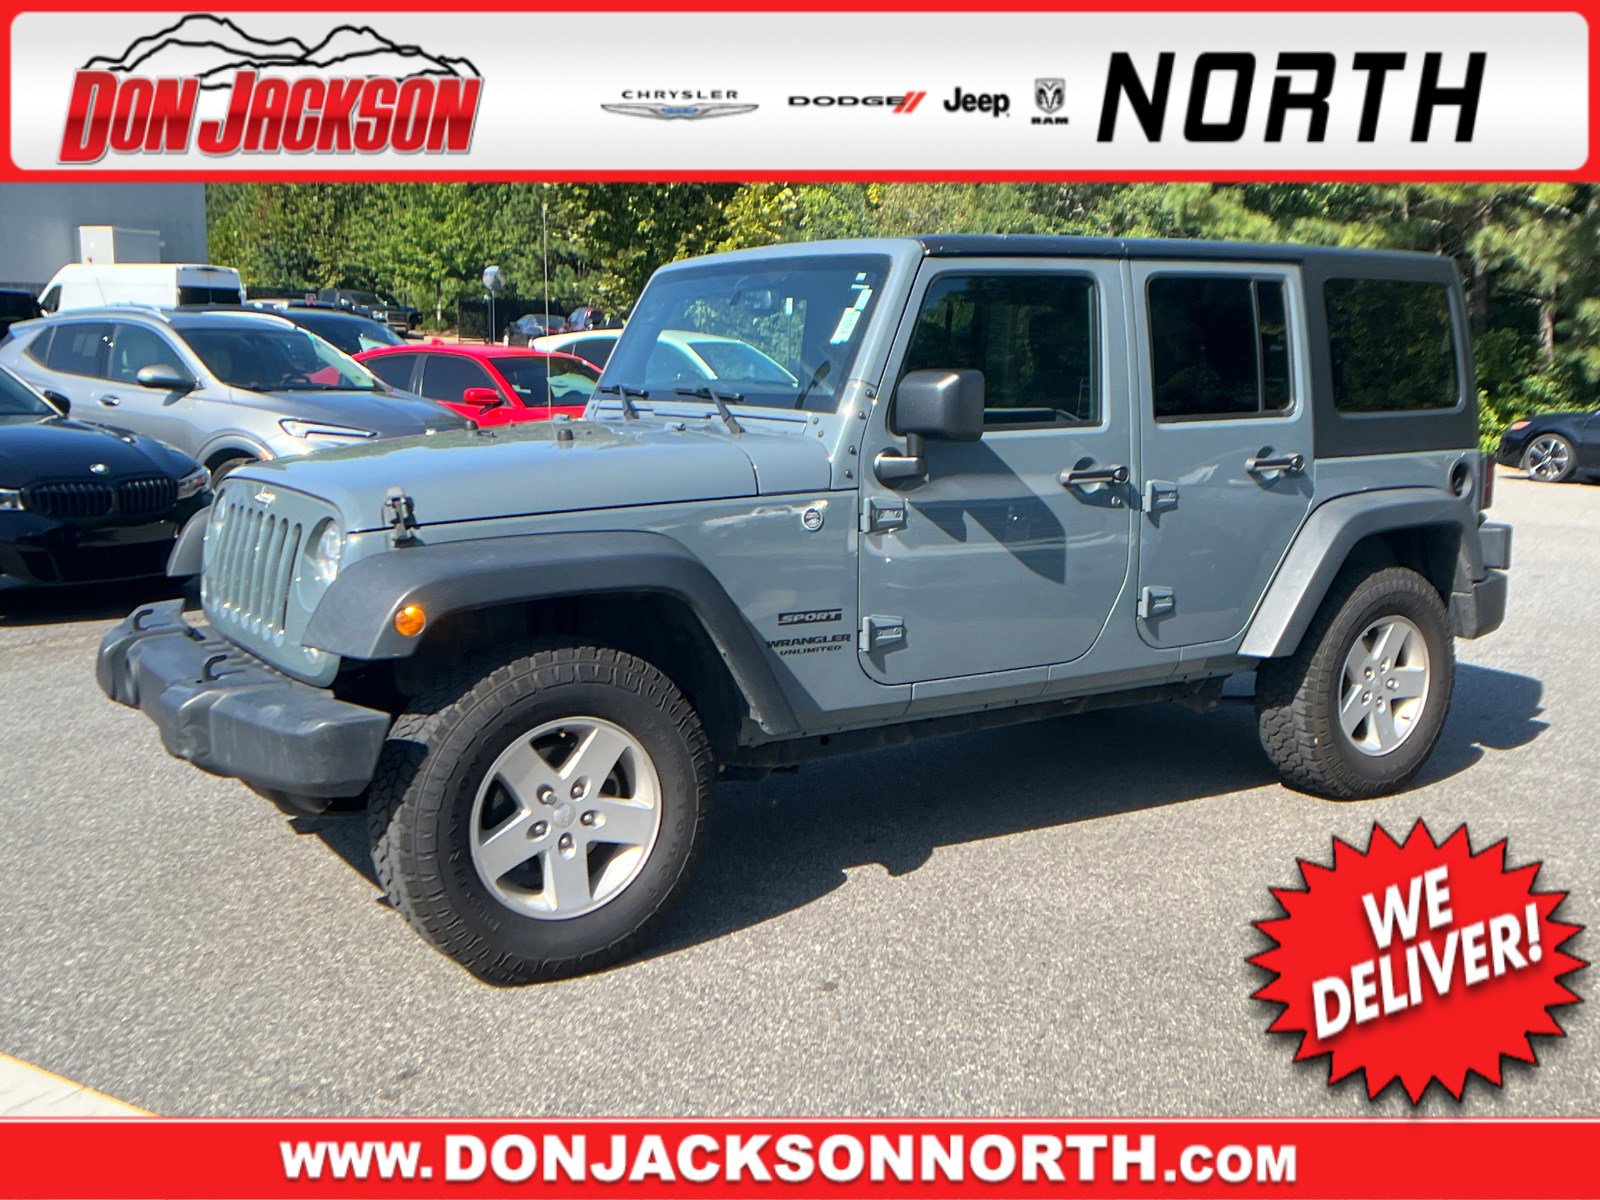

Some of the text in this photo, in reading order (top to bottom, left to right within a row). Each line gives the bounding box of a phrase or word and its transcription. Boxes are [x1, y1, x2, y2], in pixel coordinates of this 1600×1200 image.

[780, 610, 841, 624] SPORT
[767, 634, 851, 648] WRANGLER
[780, 645, 842, 656] UNLIMITED
